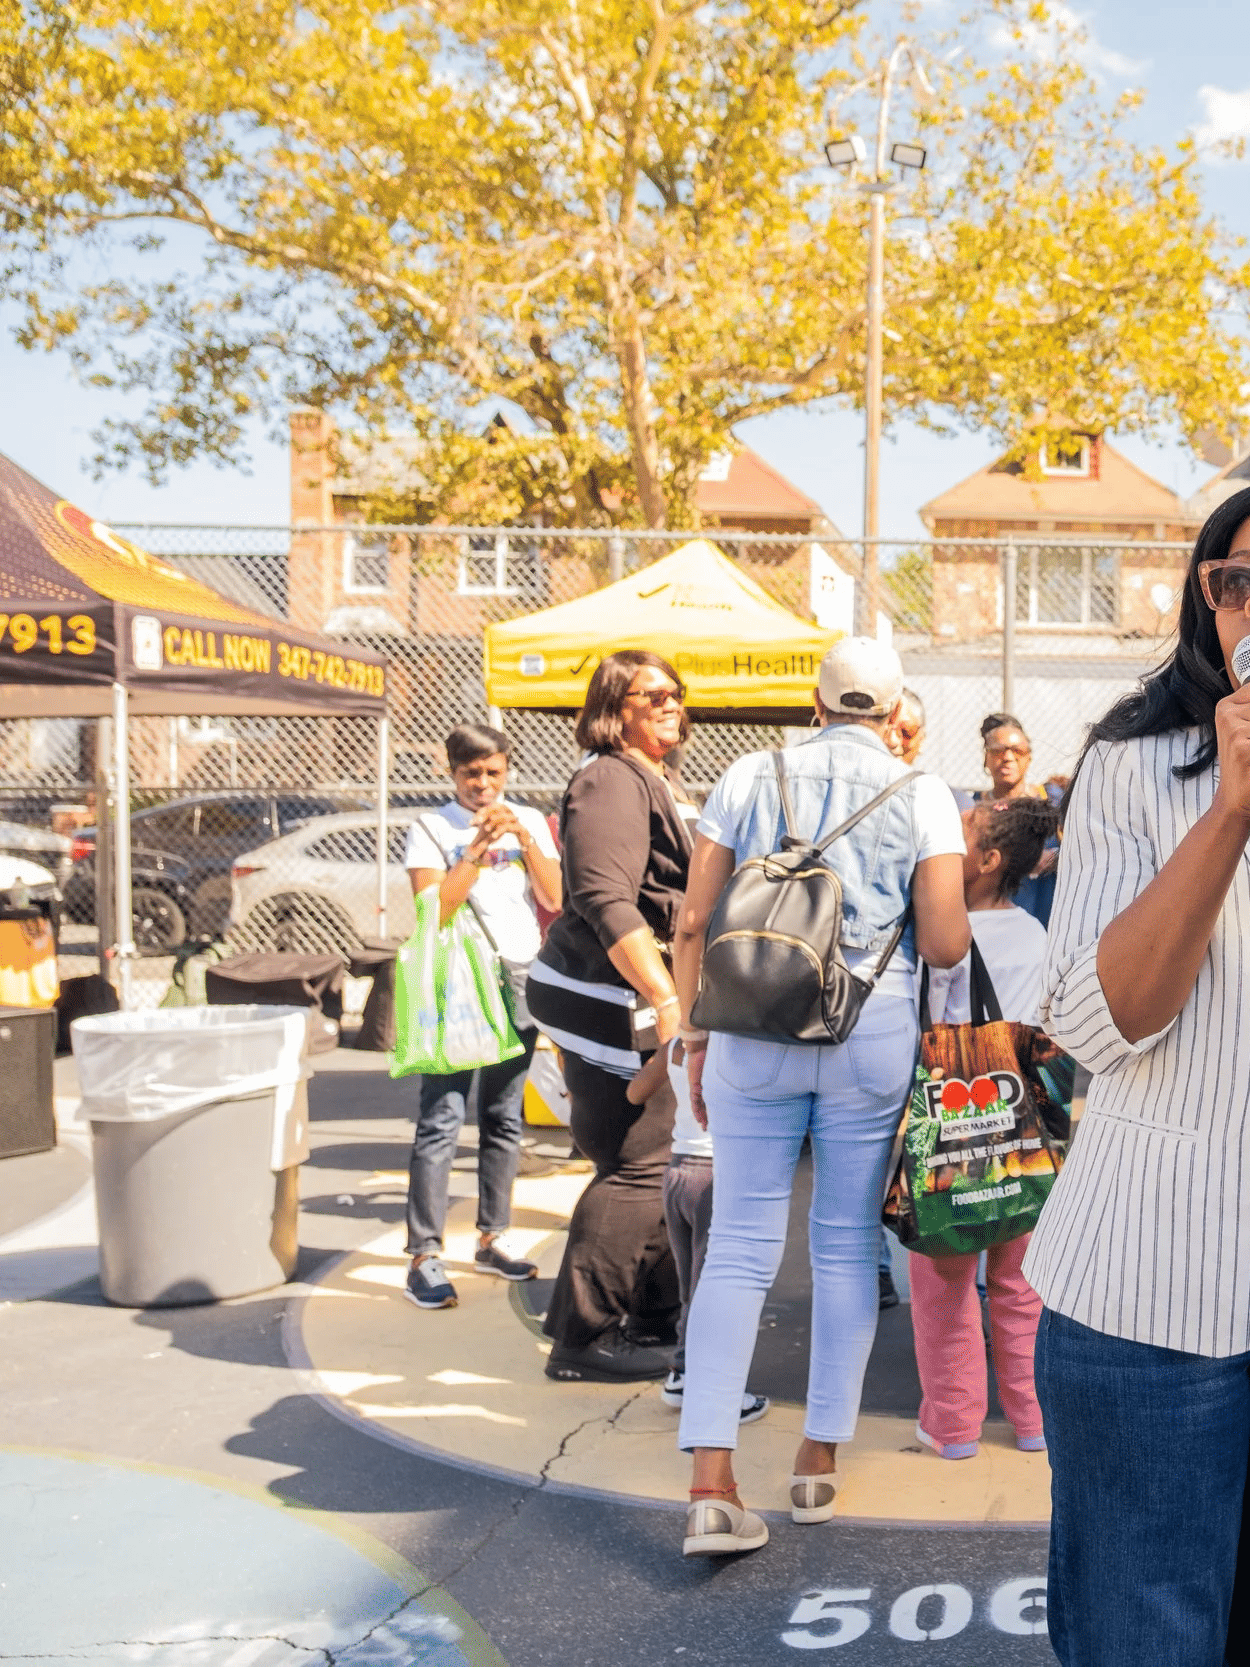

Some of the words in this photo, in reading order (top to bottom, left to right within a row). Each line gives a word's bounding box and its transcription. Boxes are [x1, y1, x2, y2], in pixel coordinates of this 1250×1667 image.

[163, 626, 225, 669] CALL
[223, 633, 271, 674] NOW
[277, 641, 385, 697] 347-742-7913
[926, 1072, 1021, 1119] FOOD
[941, 1099, 1009, 1122] BAZAAR
[951, 1181, 1022, 1206] FOODBAZAAR.COM
[780, 1577, 1048, 1650] 506
